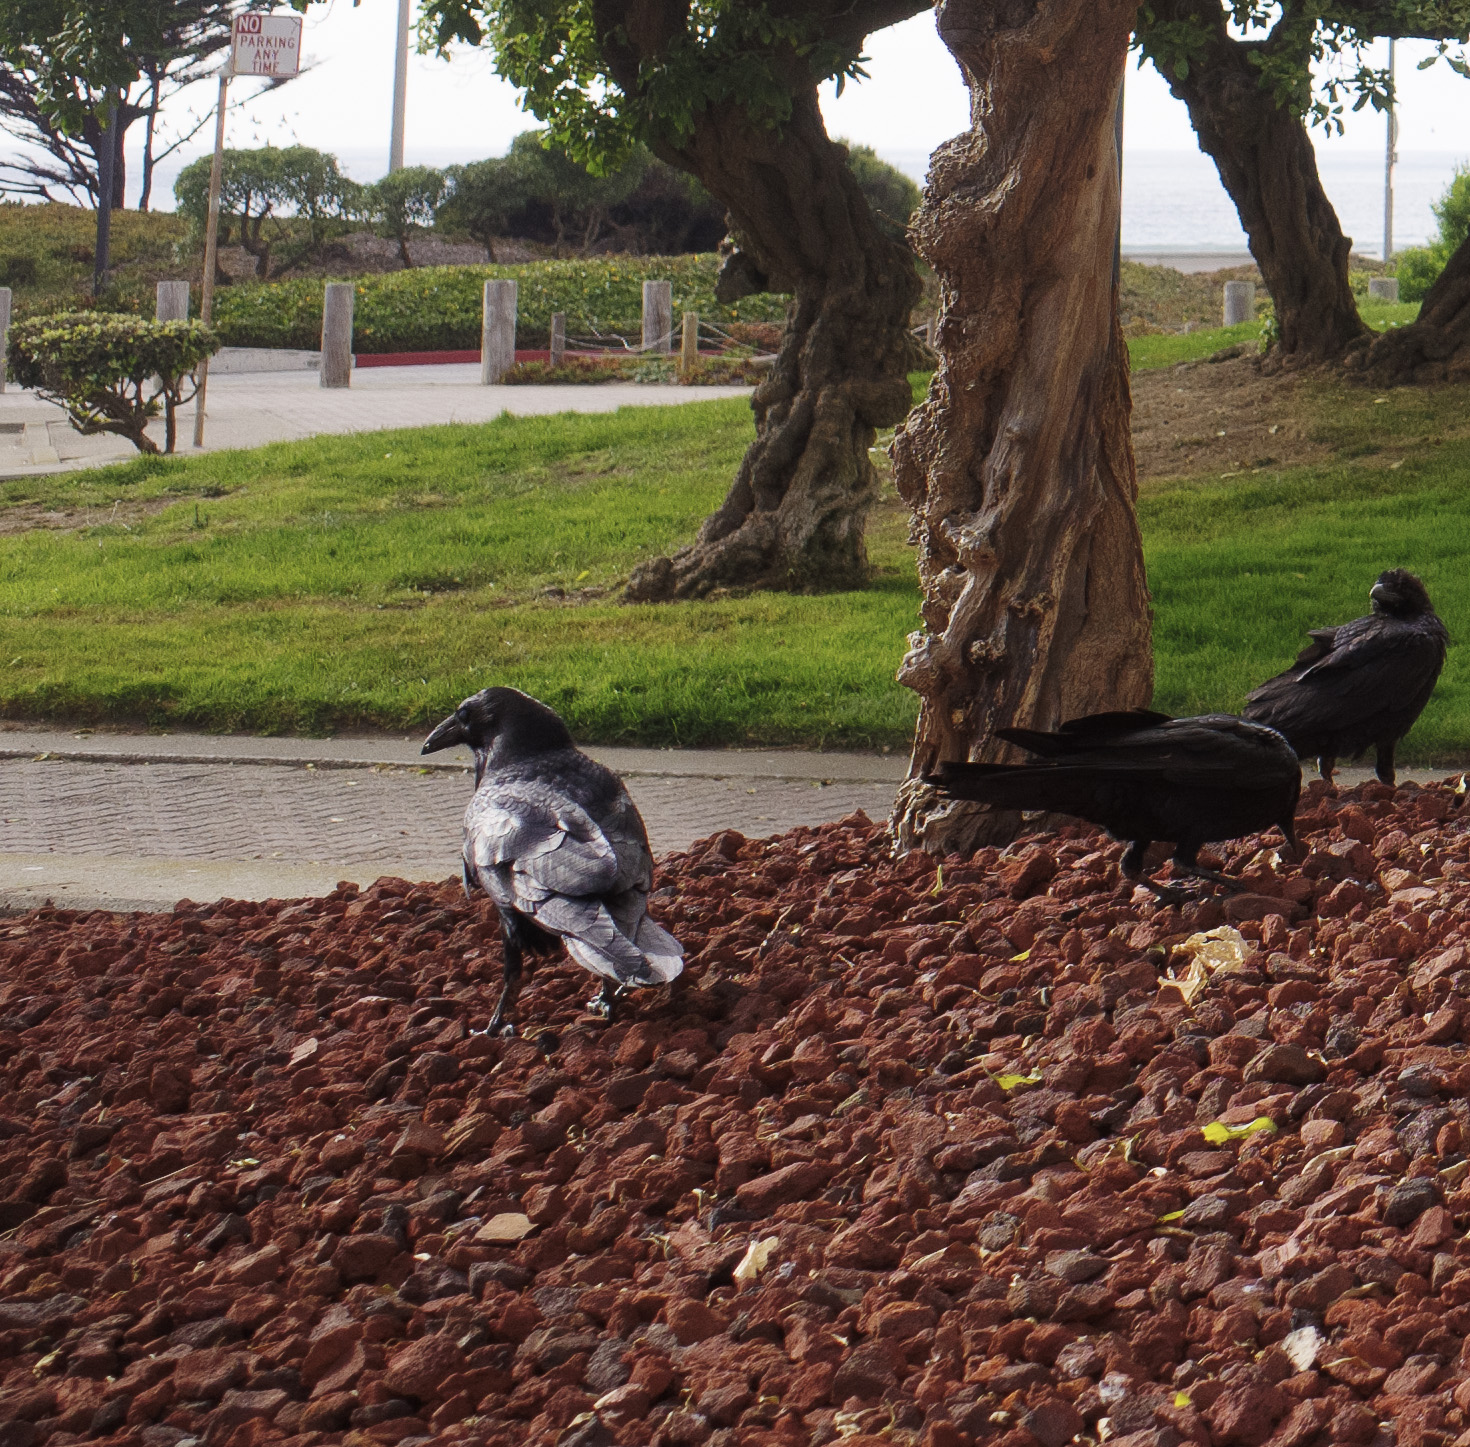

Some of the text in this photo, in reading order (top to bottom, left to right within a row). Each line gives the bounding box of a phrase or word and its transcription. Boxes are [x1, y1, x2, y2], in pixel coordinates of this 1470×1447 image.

[237, 15, 260, 32] NO
[240, 35, 296, 49] PARKING
[254, 49, 280, 61] ANY
